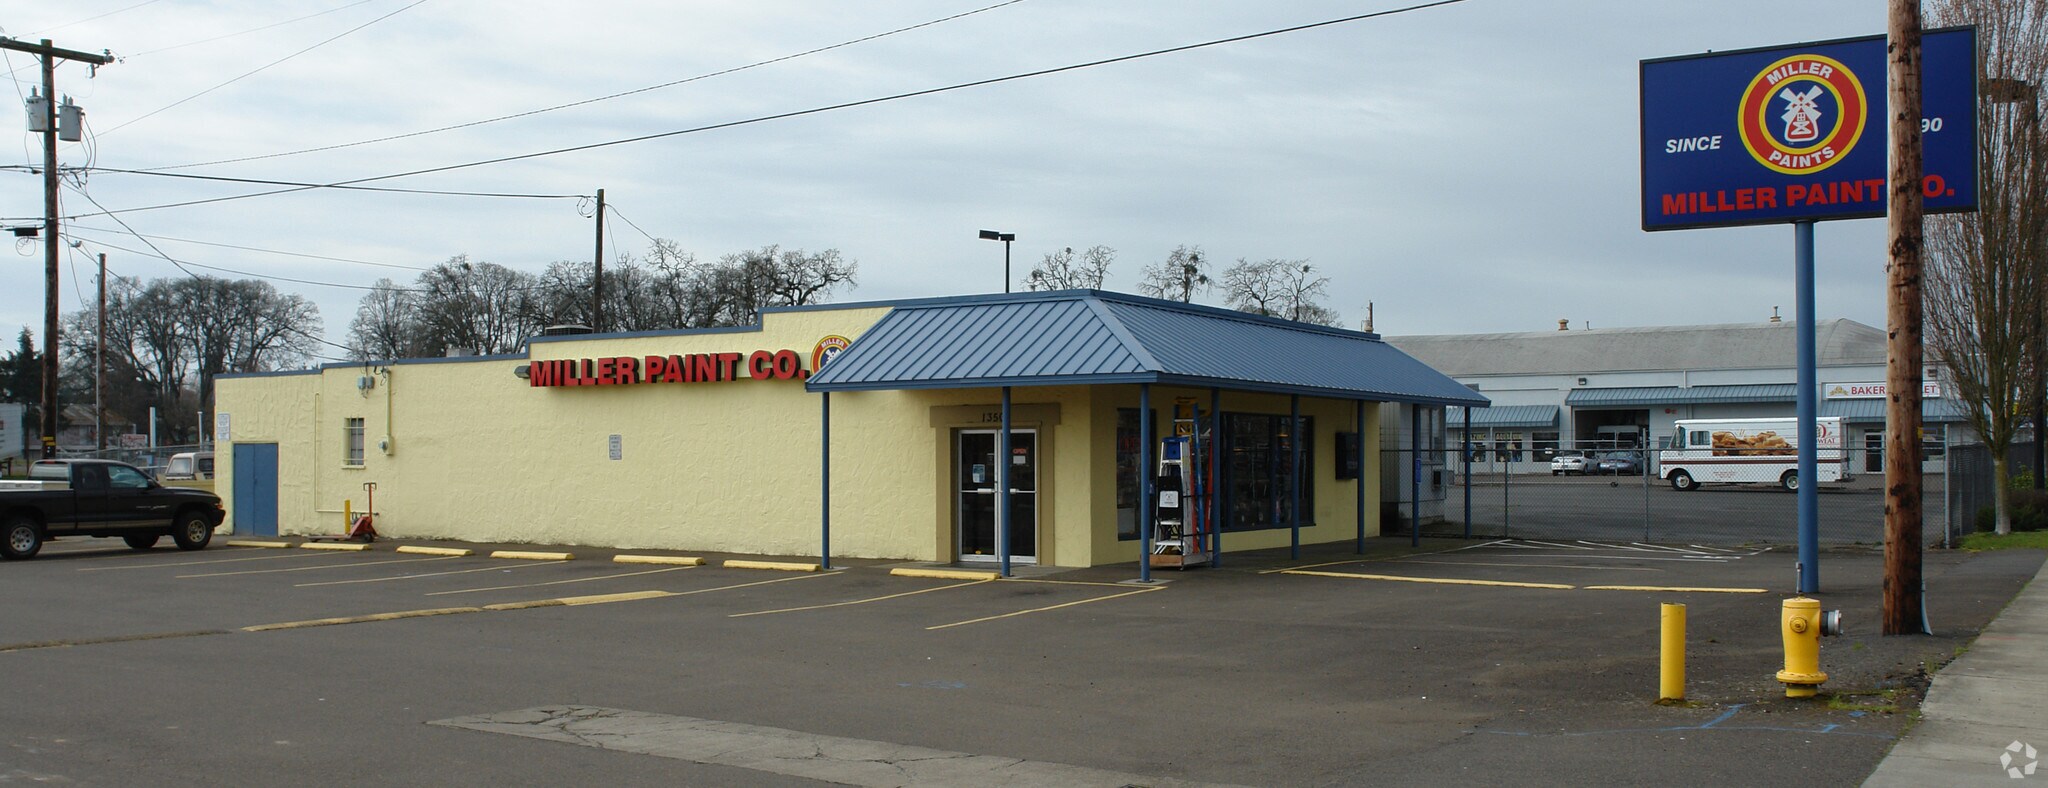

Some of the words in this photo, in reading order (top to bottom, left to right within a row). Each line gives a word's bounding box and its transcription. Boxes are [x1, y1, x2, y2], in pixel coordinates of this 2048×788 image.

[1766, 62, 1833, 85] MILLER
[1665, 135, 1722, 153] SINCE
[1922, 117, 1943, 133] 90
[1768, 146, 1835, 168] PAINTS
[1662, 187, 1777, 216] MILLER
[1787, 179, 1885, 207] PAINT
[1922, 174, 1955, 198] O.
[820, 338, 845, 349] MILLER
[530, 357, 638, 387] MILLER
[645, 352, 742, 383] PAINT
[749, 349, 808, 380] CO.
[1851, 386, 1886, 395] BAKER
